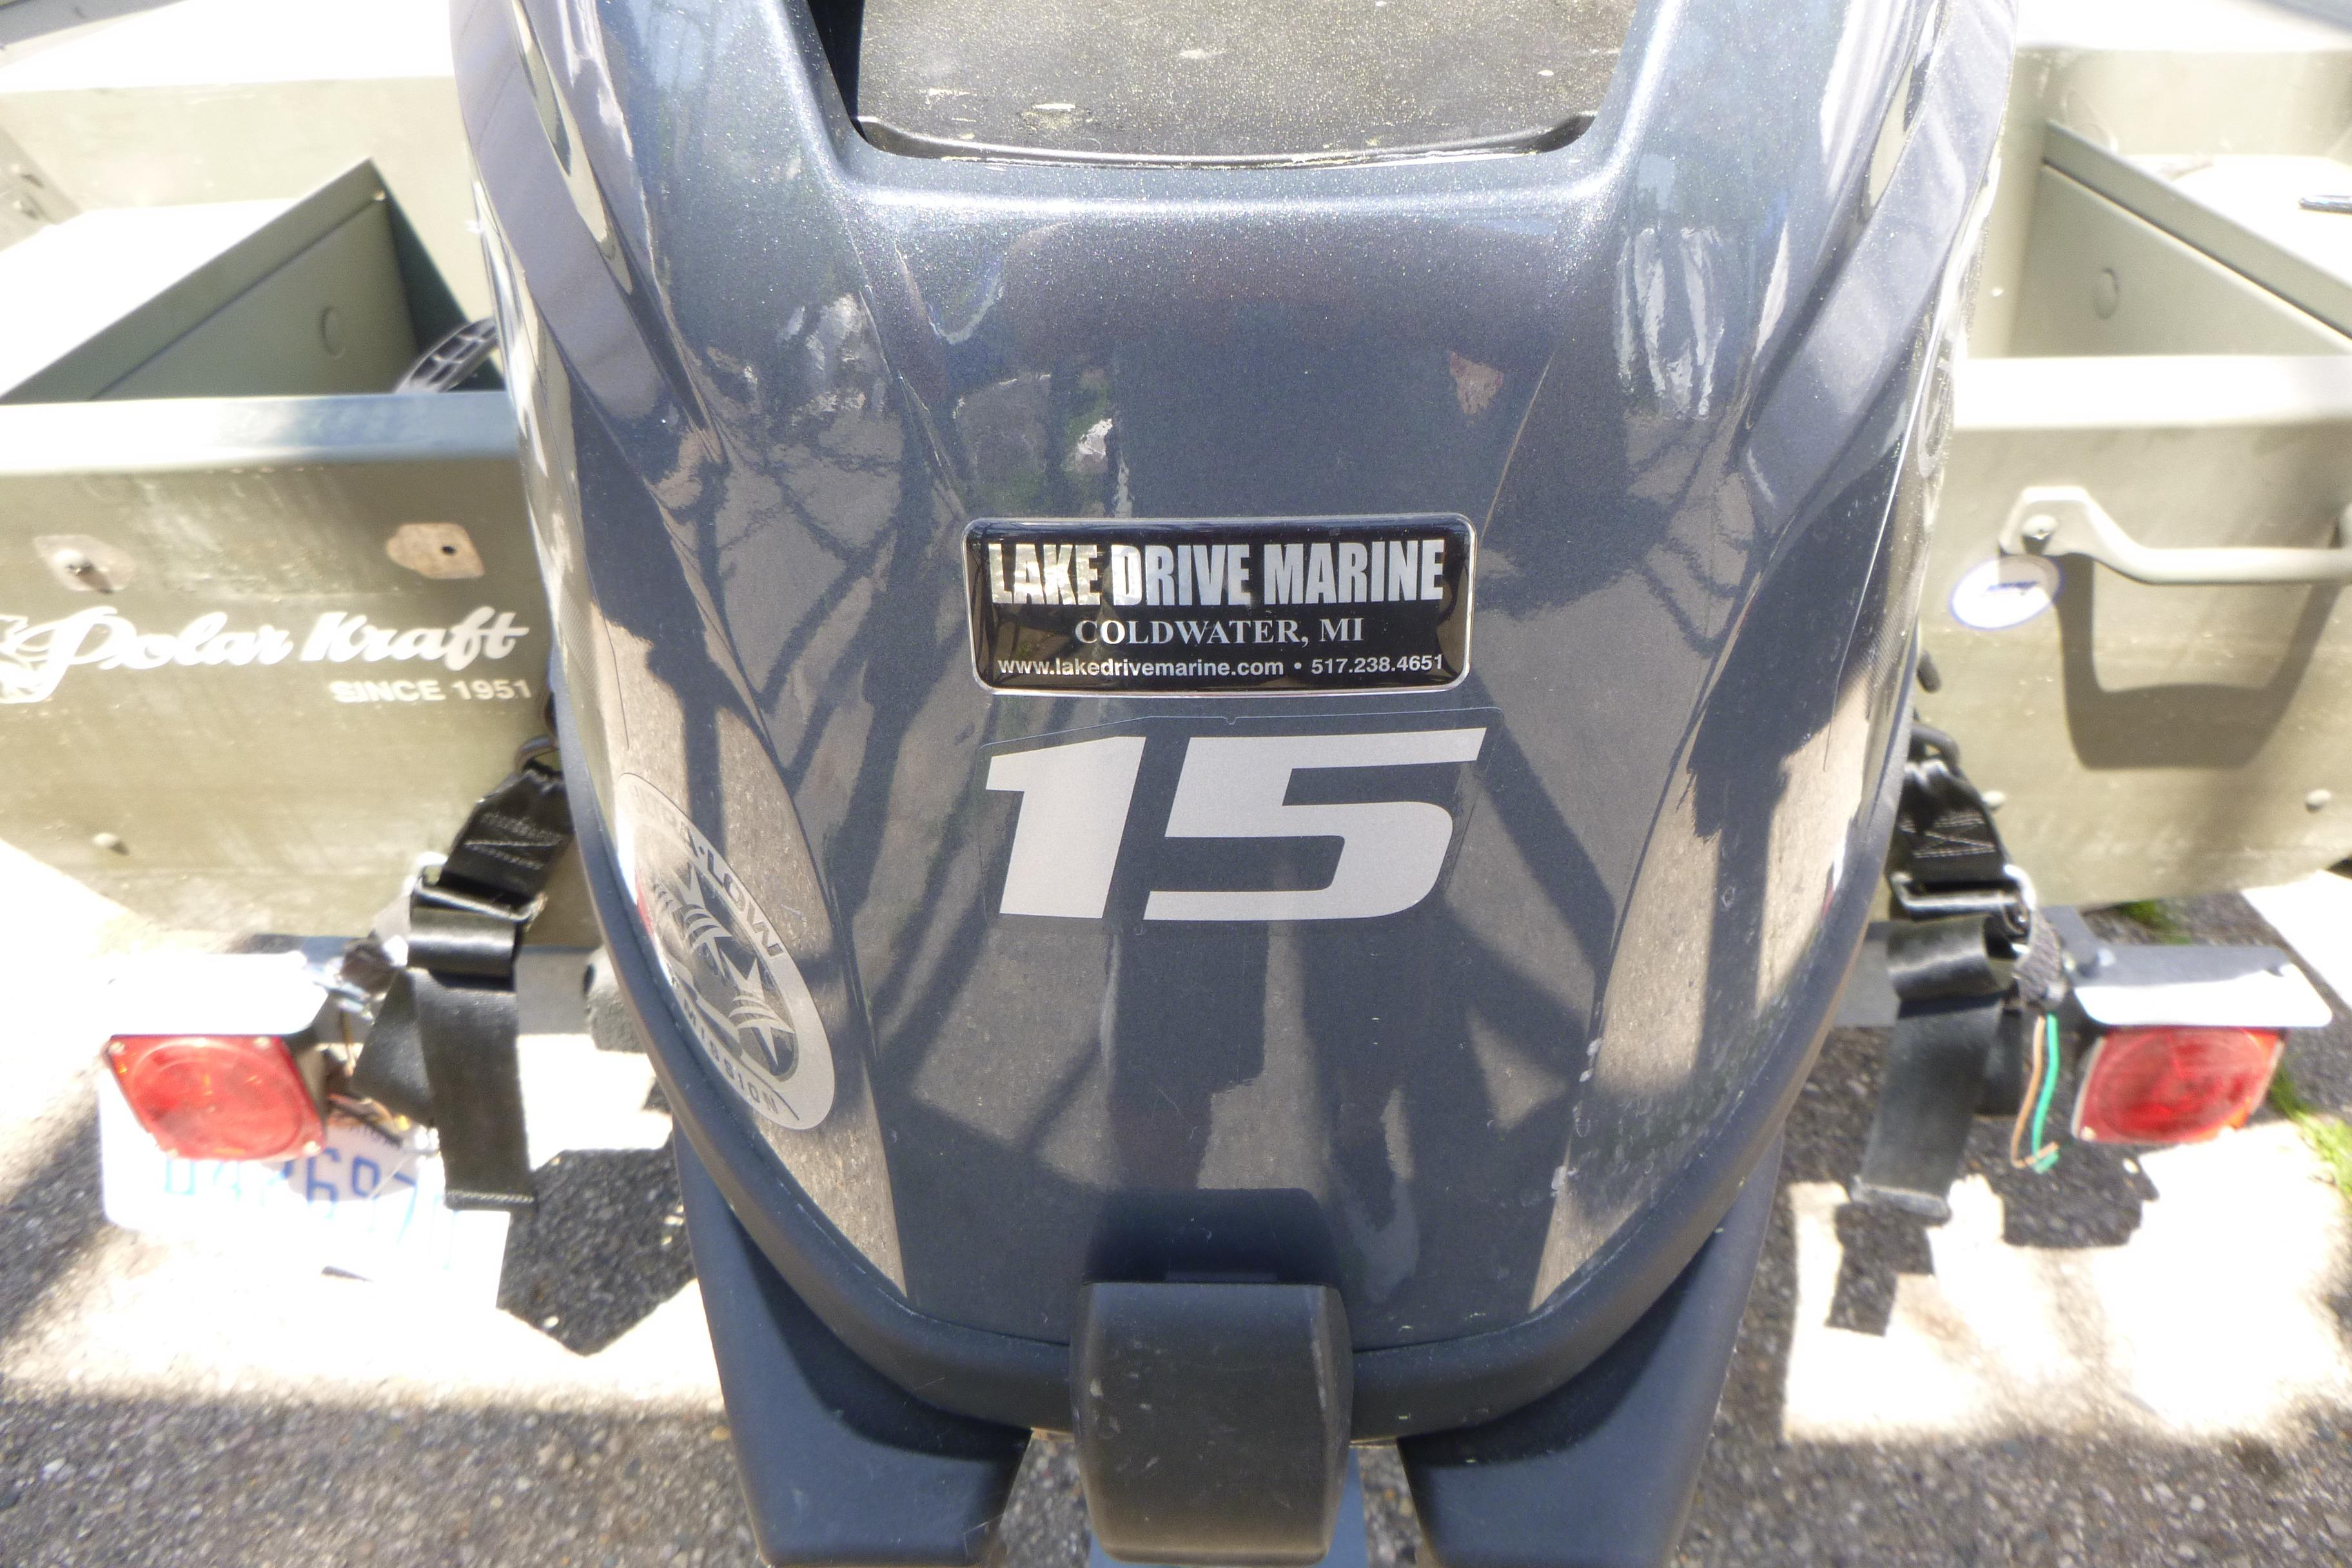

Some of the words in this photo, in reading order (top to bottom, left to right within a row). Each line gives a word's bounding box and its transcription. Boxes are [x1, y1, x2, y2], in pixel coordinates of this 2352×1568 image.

[987, 543, 1102, 606] LAKE
[1111, 543, 1251, 606] DRIVE
[1263, 538, 1446, 605] MARINE
[15, 605, 293, 703] Polar
[300, 606, 529, 671] Kraft
[1074, 619, 1309, 648] COLDWATER,
[1320, 618, 1364, 643] MI
[329, 679, 447, 703] SINCE
[453, 678, 532, 701] 1951
[997, 656, 1284, 678] www.lakedrivemarine.com
[1311, 654, 1444, 676] 517.238.4651
[986, 727, 1487, 921] 15
